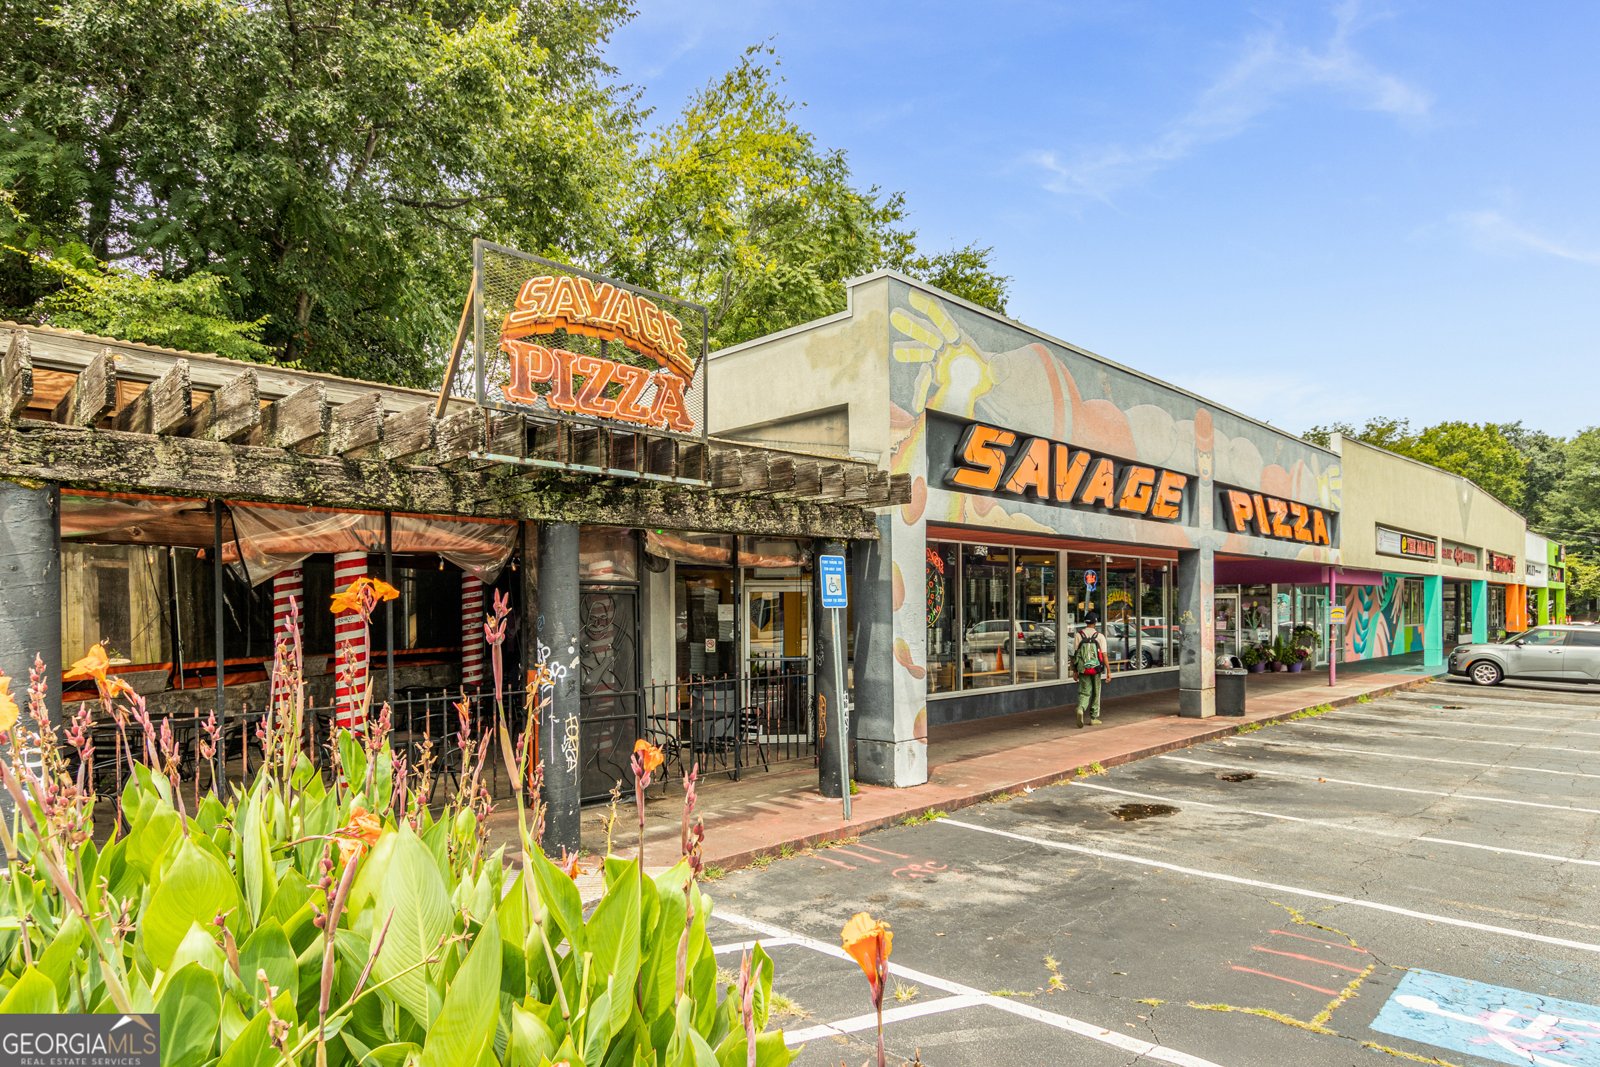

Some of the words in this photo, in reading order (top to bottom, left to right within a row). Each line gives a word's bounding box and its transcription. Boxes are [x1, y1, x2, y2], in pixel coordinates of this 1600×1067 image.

[510, 276, 695, 371] SAVAGE
[500, 340, 695, 431] PIZZA
[945, 423, 1188, 520] SAVAGE
[1223, 489, 1330, 546] PIZZA
